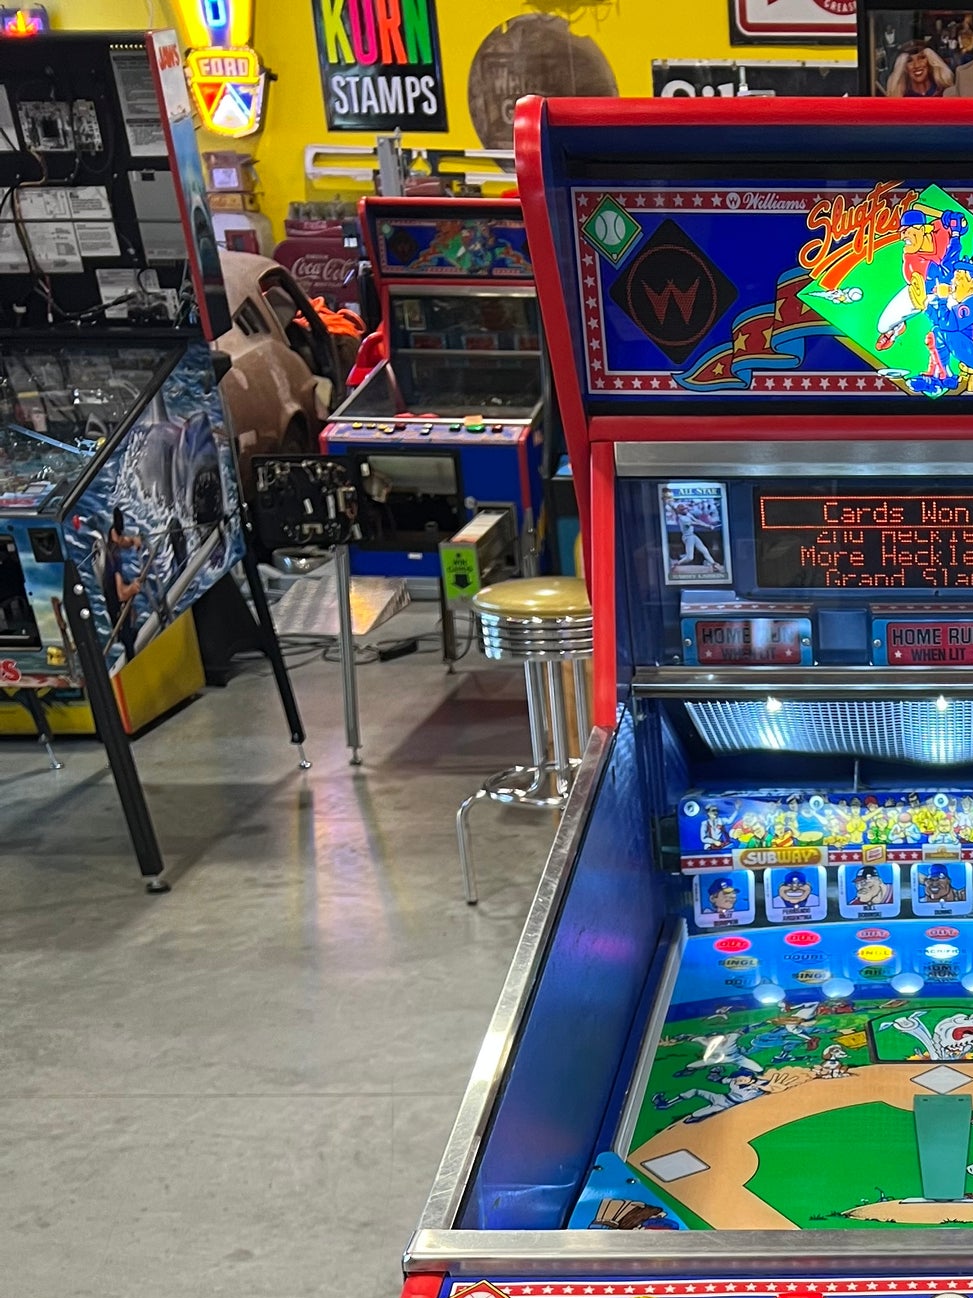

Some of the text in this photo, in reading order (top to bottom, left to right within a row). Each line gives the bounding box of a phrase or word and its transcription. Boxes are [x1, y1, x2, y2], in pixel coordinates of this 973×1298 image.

[199, 57, 249, 77] FORD
[330, 75, 438, 115] STAMPS
[743, 193, 806, 210] Williams
[695, 487, 718, 495] STAR
[823, 501, 904, 523] Cards
[922, 501, 970, 523] Won
[801, 545, 864, 566] More
[825, 568, 905, 586] Grand
[702, 627, 751, 645] HOME
[892, 628, 942, 645] HOME
[911, 647, 966, 661] WHEN LIT
[743, 849, 819, 865] SUBWAY
[719, 940, 746, 948] OUT
